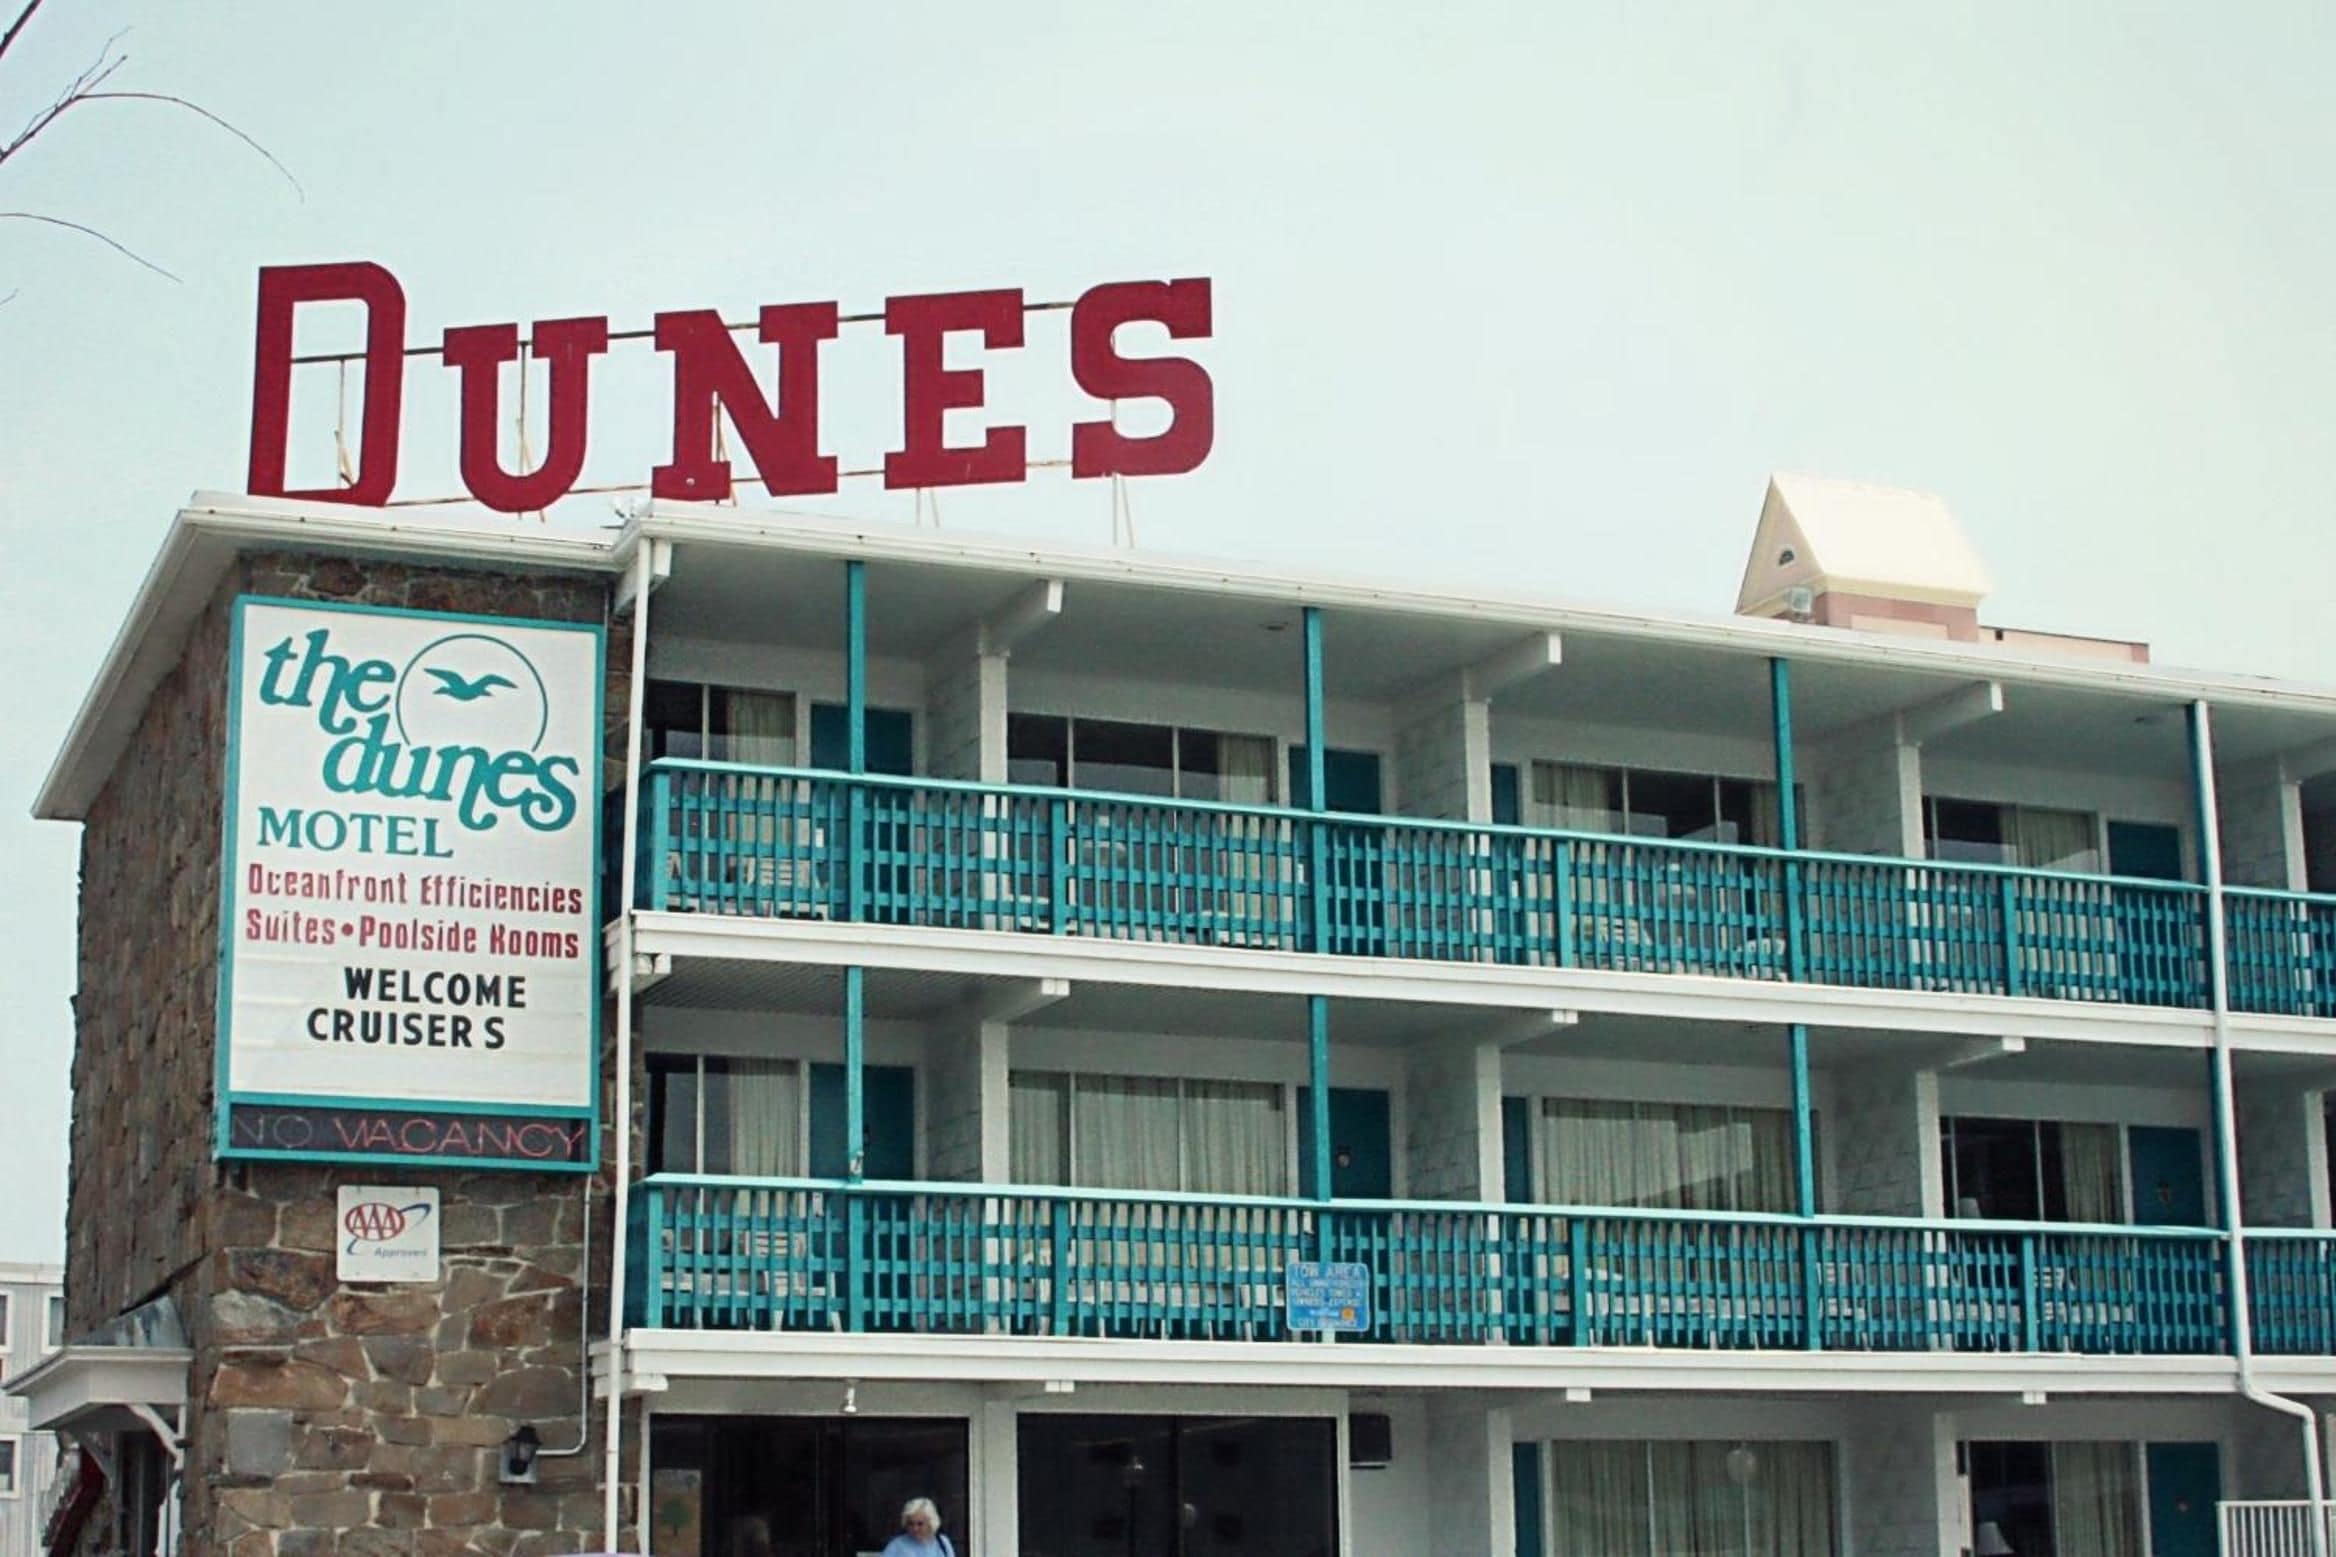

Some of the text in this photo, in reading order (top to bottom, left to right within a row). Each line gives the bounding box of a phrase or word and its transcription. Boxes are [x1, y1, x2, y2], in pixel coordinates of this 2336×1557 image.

[247, 261, 1213, 513] DUNES
[259, 629, 396, 734] the
[323, 714, 580, 831] dunes
[257, 807, 454, 858] MOTEL
[249, 863, 582, 914] Oceanfront Efficiencies
[489, 923, 580, 958] Rooms
[343, 966, 526, 1009] WELCOME
[307, 1008, 506, 1050] CRUISERS
[231, 1112, 585, 1157] NO VACANCY
[350, 1203, 401, 1240] AAA
[374, 1247, 428, 1259] Approved
